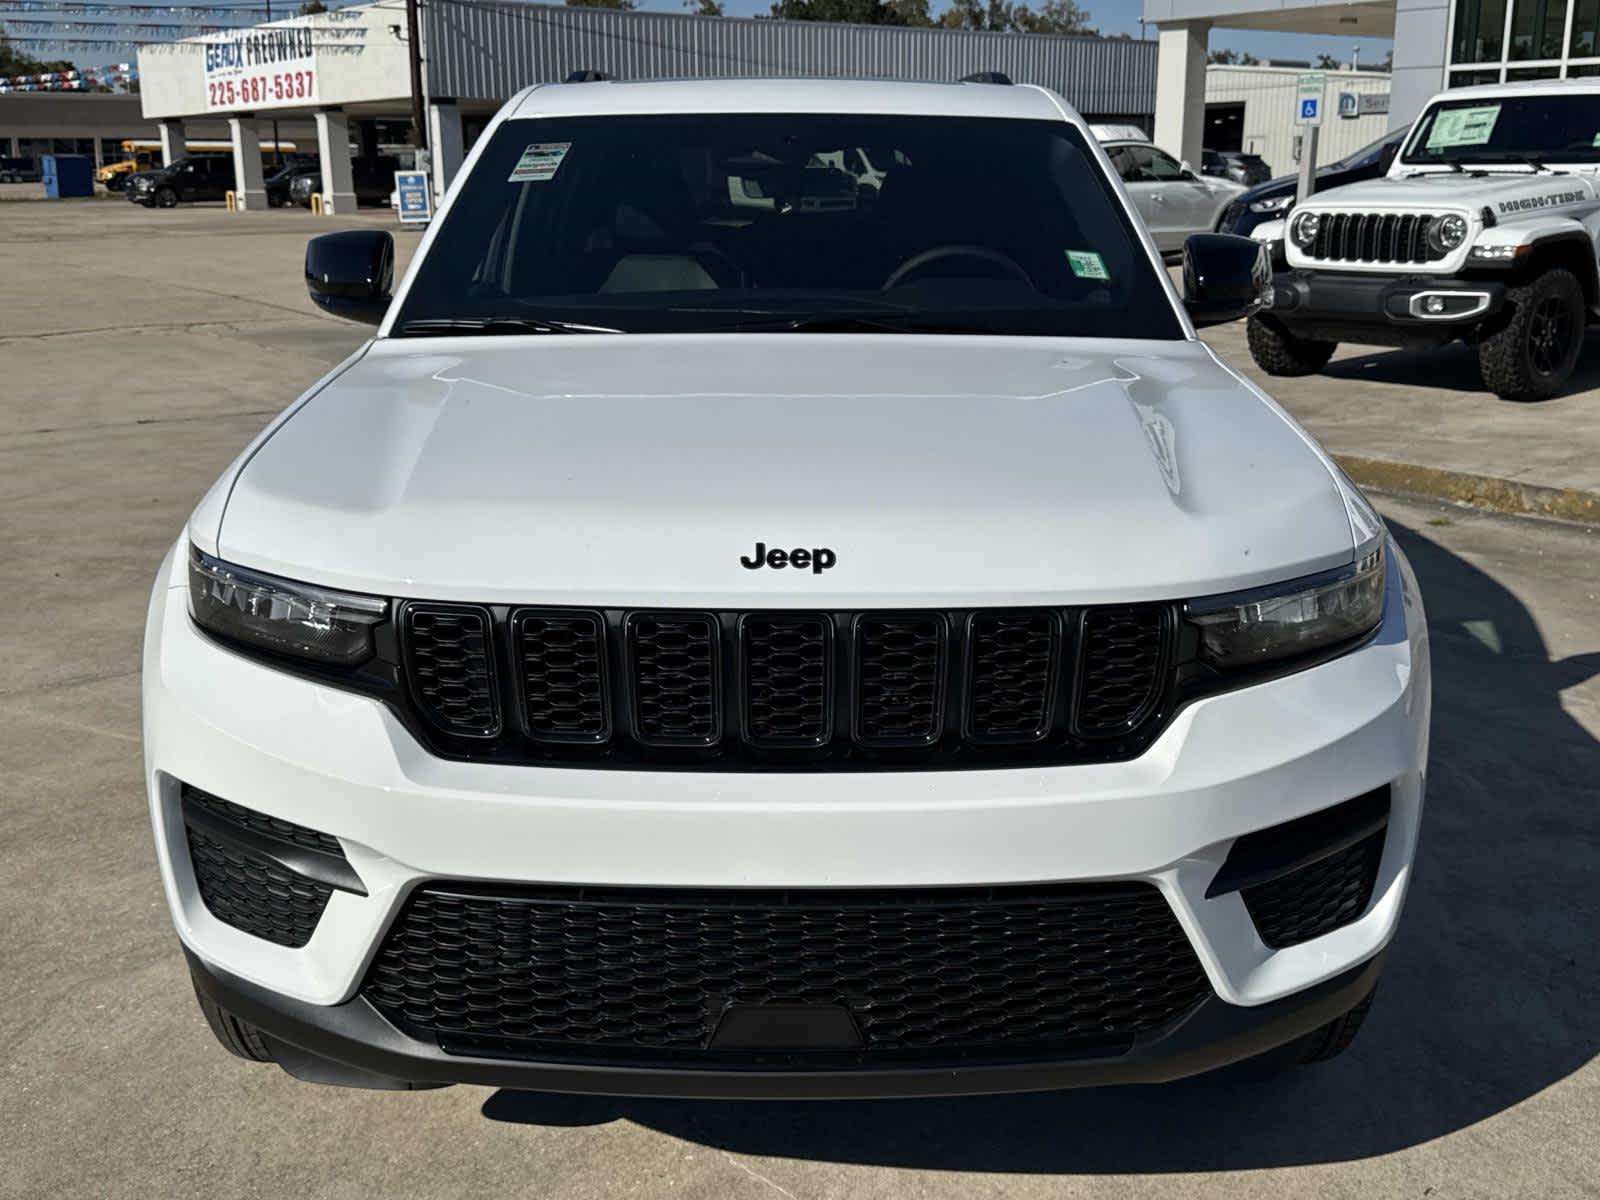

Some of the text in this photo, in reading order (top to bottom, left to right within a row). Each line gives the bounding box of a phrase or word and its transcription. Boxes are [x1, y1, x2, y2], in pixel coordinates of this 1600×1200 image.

[246, 27, 312, 66] PREOWNED
[209, 72, 313, 106] 225-687-5337
[740, 542, 836, 574] Jeep
